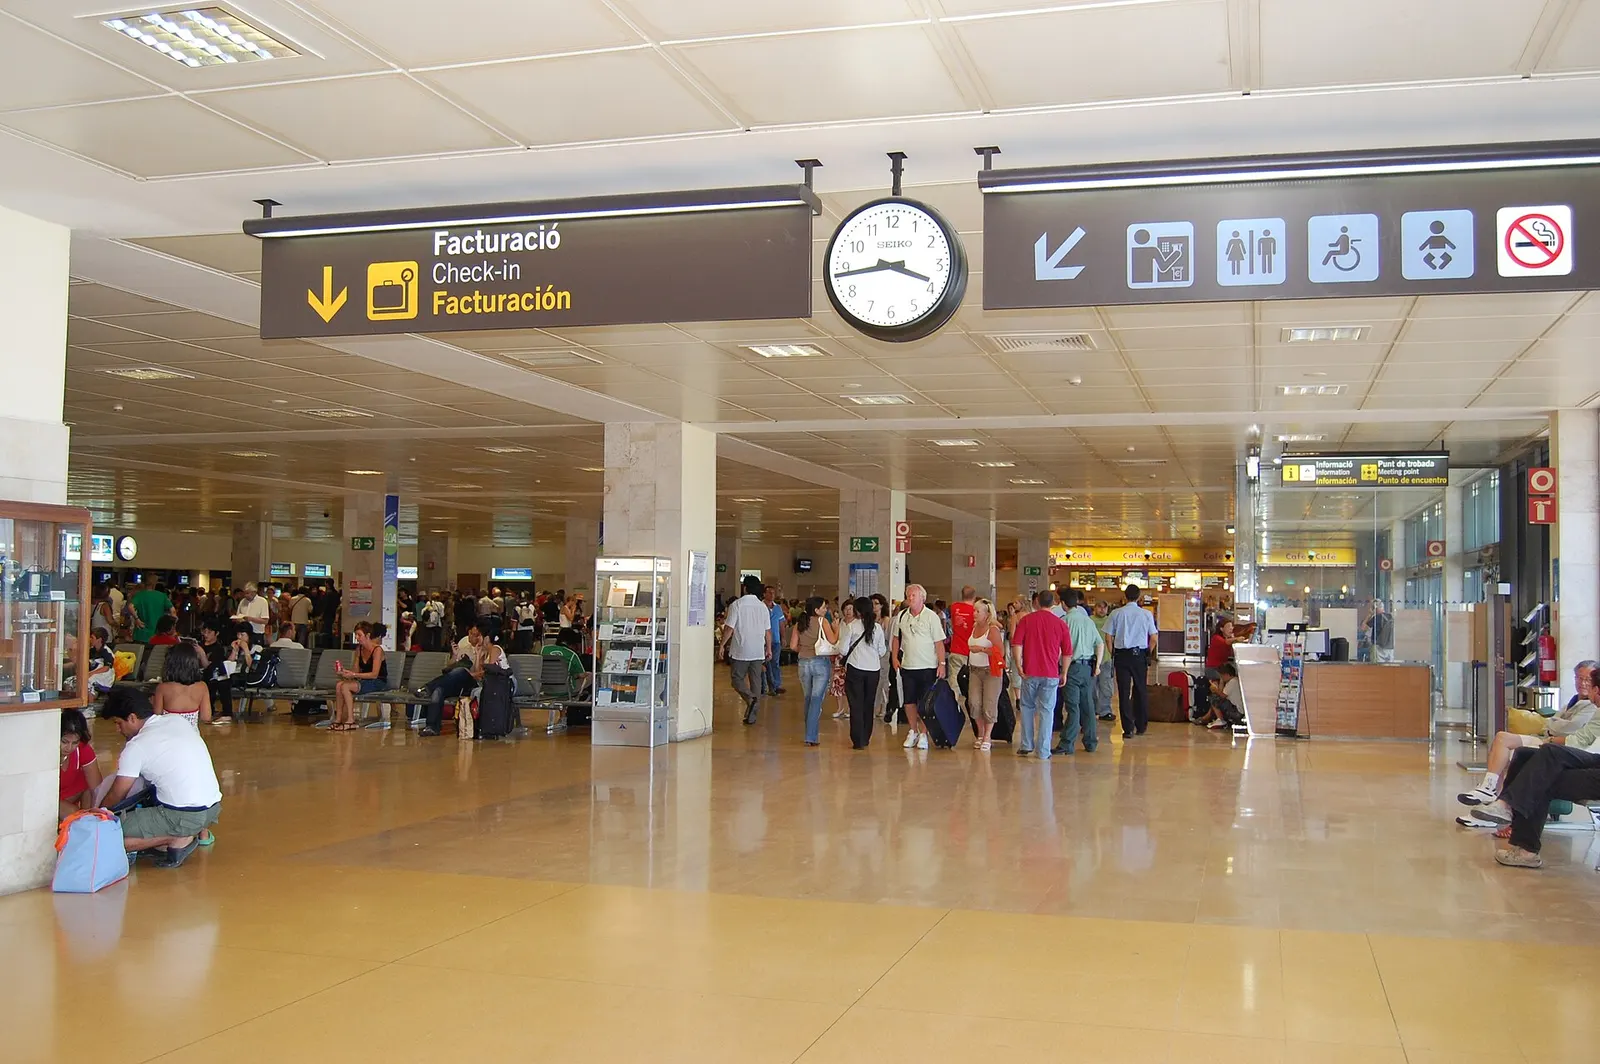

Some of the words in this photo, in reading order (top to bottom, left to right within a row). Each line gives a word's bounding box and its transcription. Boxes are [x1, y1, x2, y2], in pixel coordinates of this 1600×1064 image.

[886, 215, 900, 229] 12
[912, 220, 917, 233] 1
[866, 224, 877, 236] 11
[433, 222, 561, 256] Facturació
[877, 240, 913, 249] SEIKO
[927, 235, 935, 249] 2
[850, 240, 865, 253] 10
[842, 261, 850, 272] 9
[935, 258, 944, 272] 3
[432, 259, 521, 285] Check-in
[848, 284, 857, 298] 8
[926, 282, 934, 295] 4
[432, 284, 571, 316] Facturación
[867, 300, 875, 313] 7
[910, 299, 918, 312] 5
[887, 305, 895, 319] 6
[1315, 460, 1353, 469] Informació
[1377, 460, 1396, 468] Punt
[1396, 460, 1406, 468] de
[1407, 460, 1435, 468] trobada
[1377, 468, 1402, 477] Meeting
[1403, 468, 1419, 477] point
[1315, 477, 1357, 485] Información
